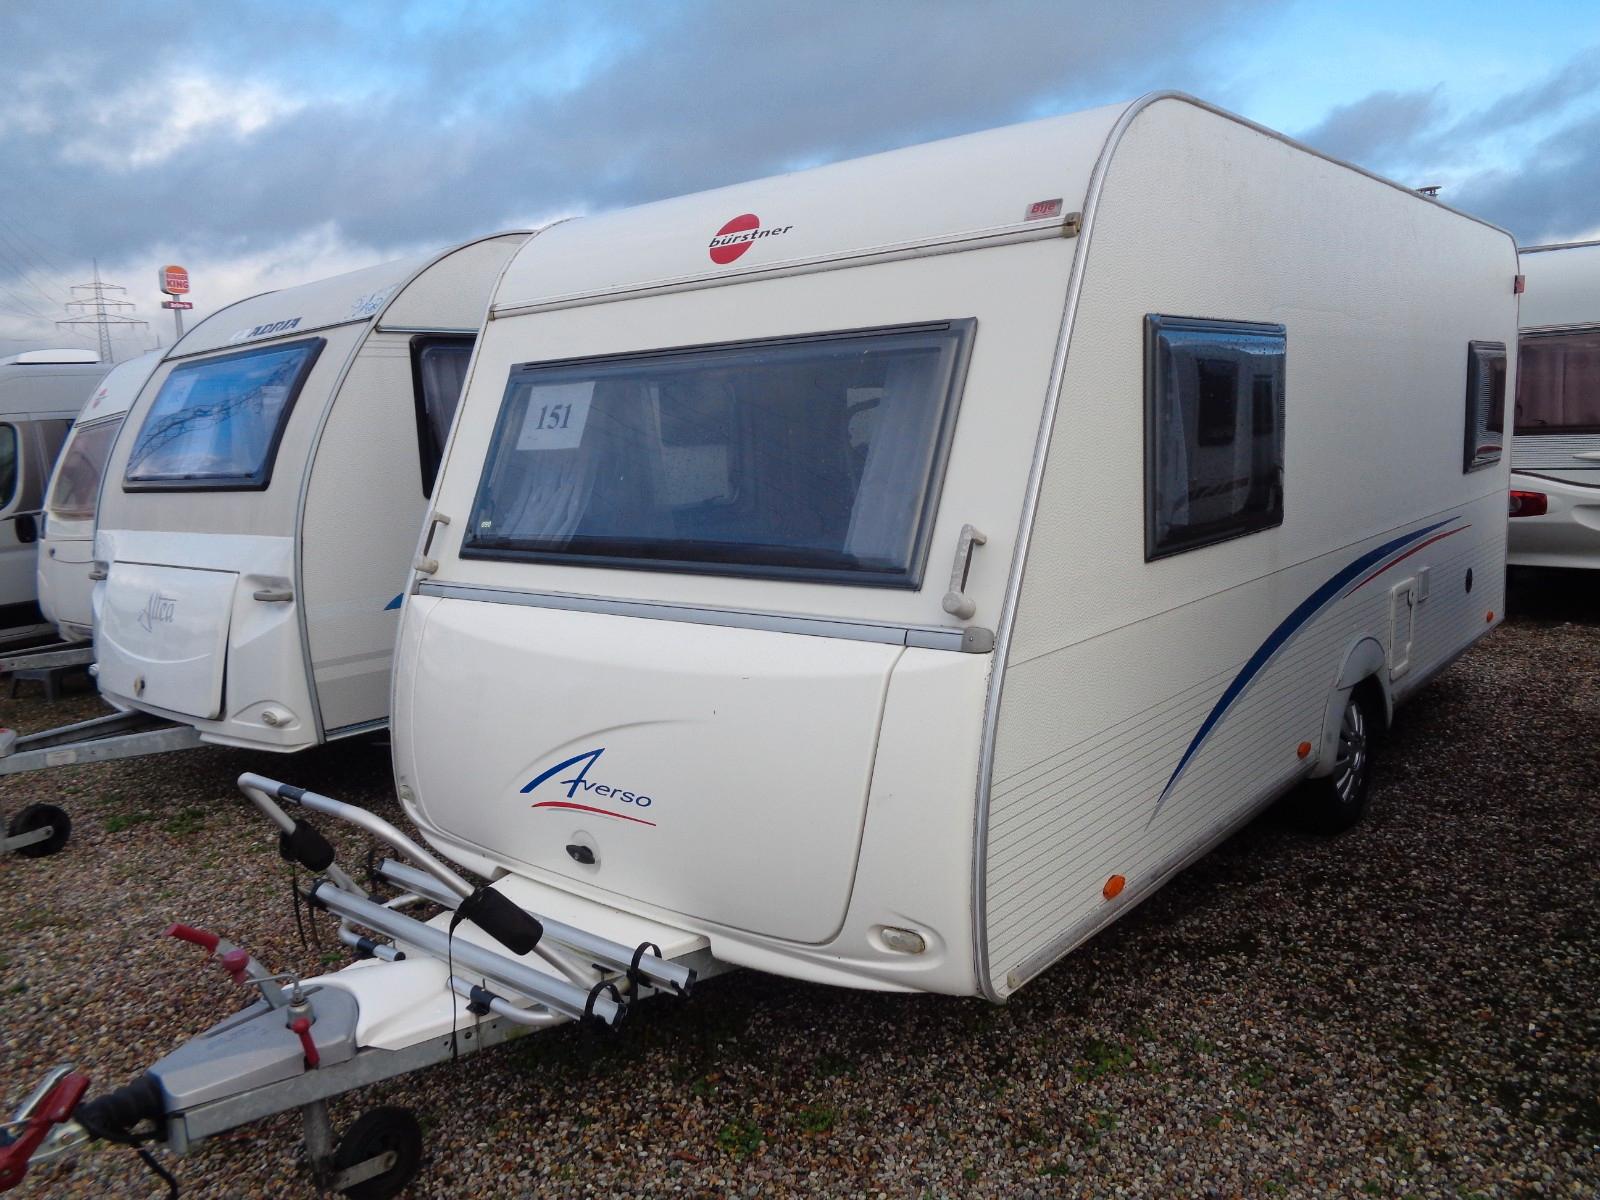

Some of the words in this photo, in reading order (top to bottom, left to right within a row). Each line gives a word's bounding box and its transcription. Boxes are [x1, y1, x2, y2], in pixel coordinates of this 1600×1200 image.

[709, 225, 793, 248] bürstner
[167, 280, 189, 289] KING
[248, 317, 302, 338] ADRIA
[536, 404, 572, 430] 151
[519, 747, 652, 808] Averso
